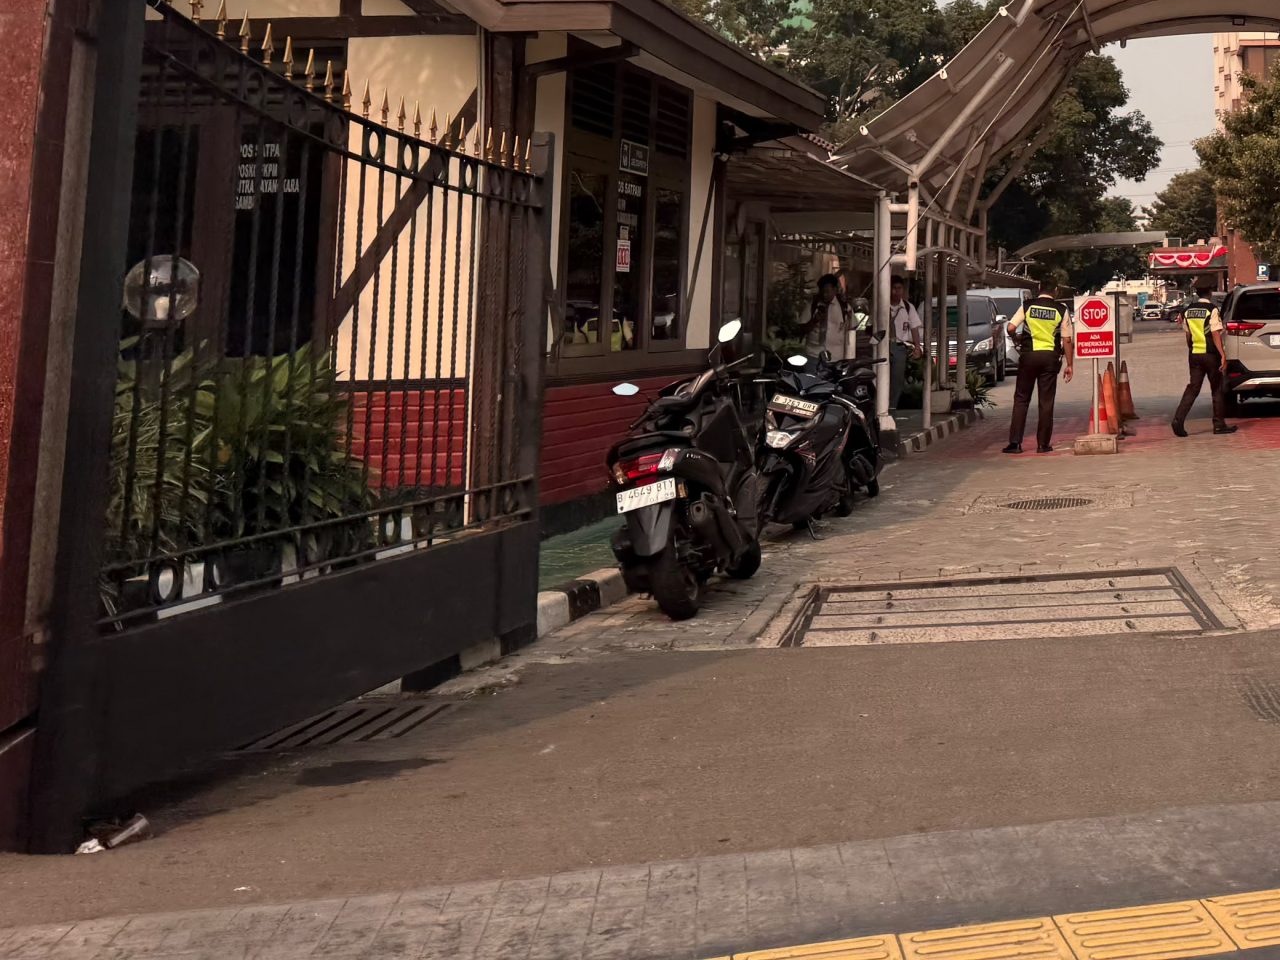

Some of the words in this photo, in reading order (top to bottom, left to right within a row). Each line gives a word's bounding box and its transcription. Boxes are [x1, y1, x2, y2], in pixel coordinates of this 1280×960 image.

[1258, 265, 1267, 275] P
[1031, 308, 1056, 319] SATPAM
[1083, 308, 1106, 320] STOP
[656, 480, 674, 492] BTY
